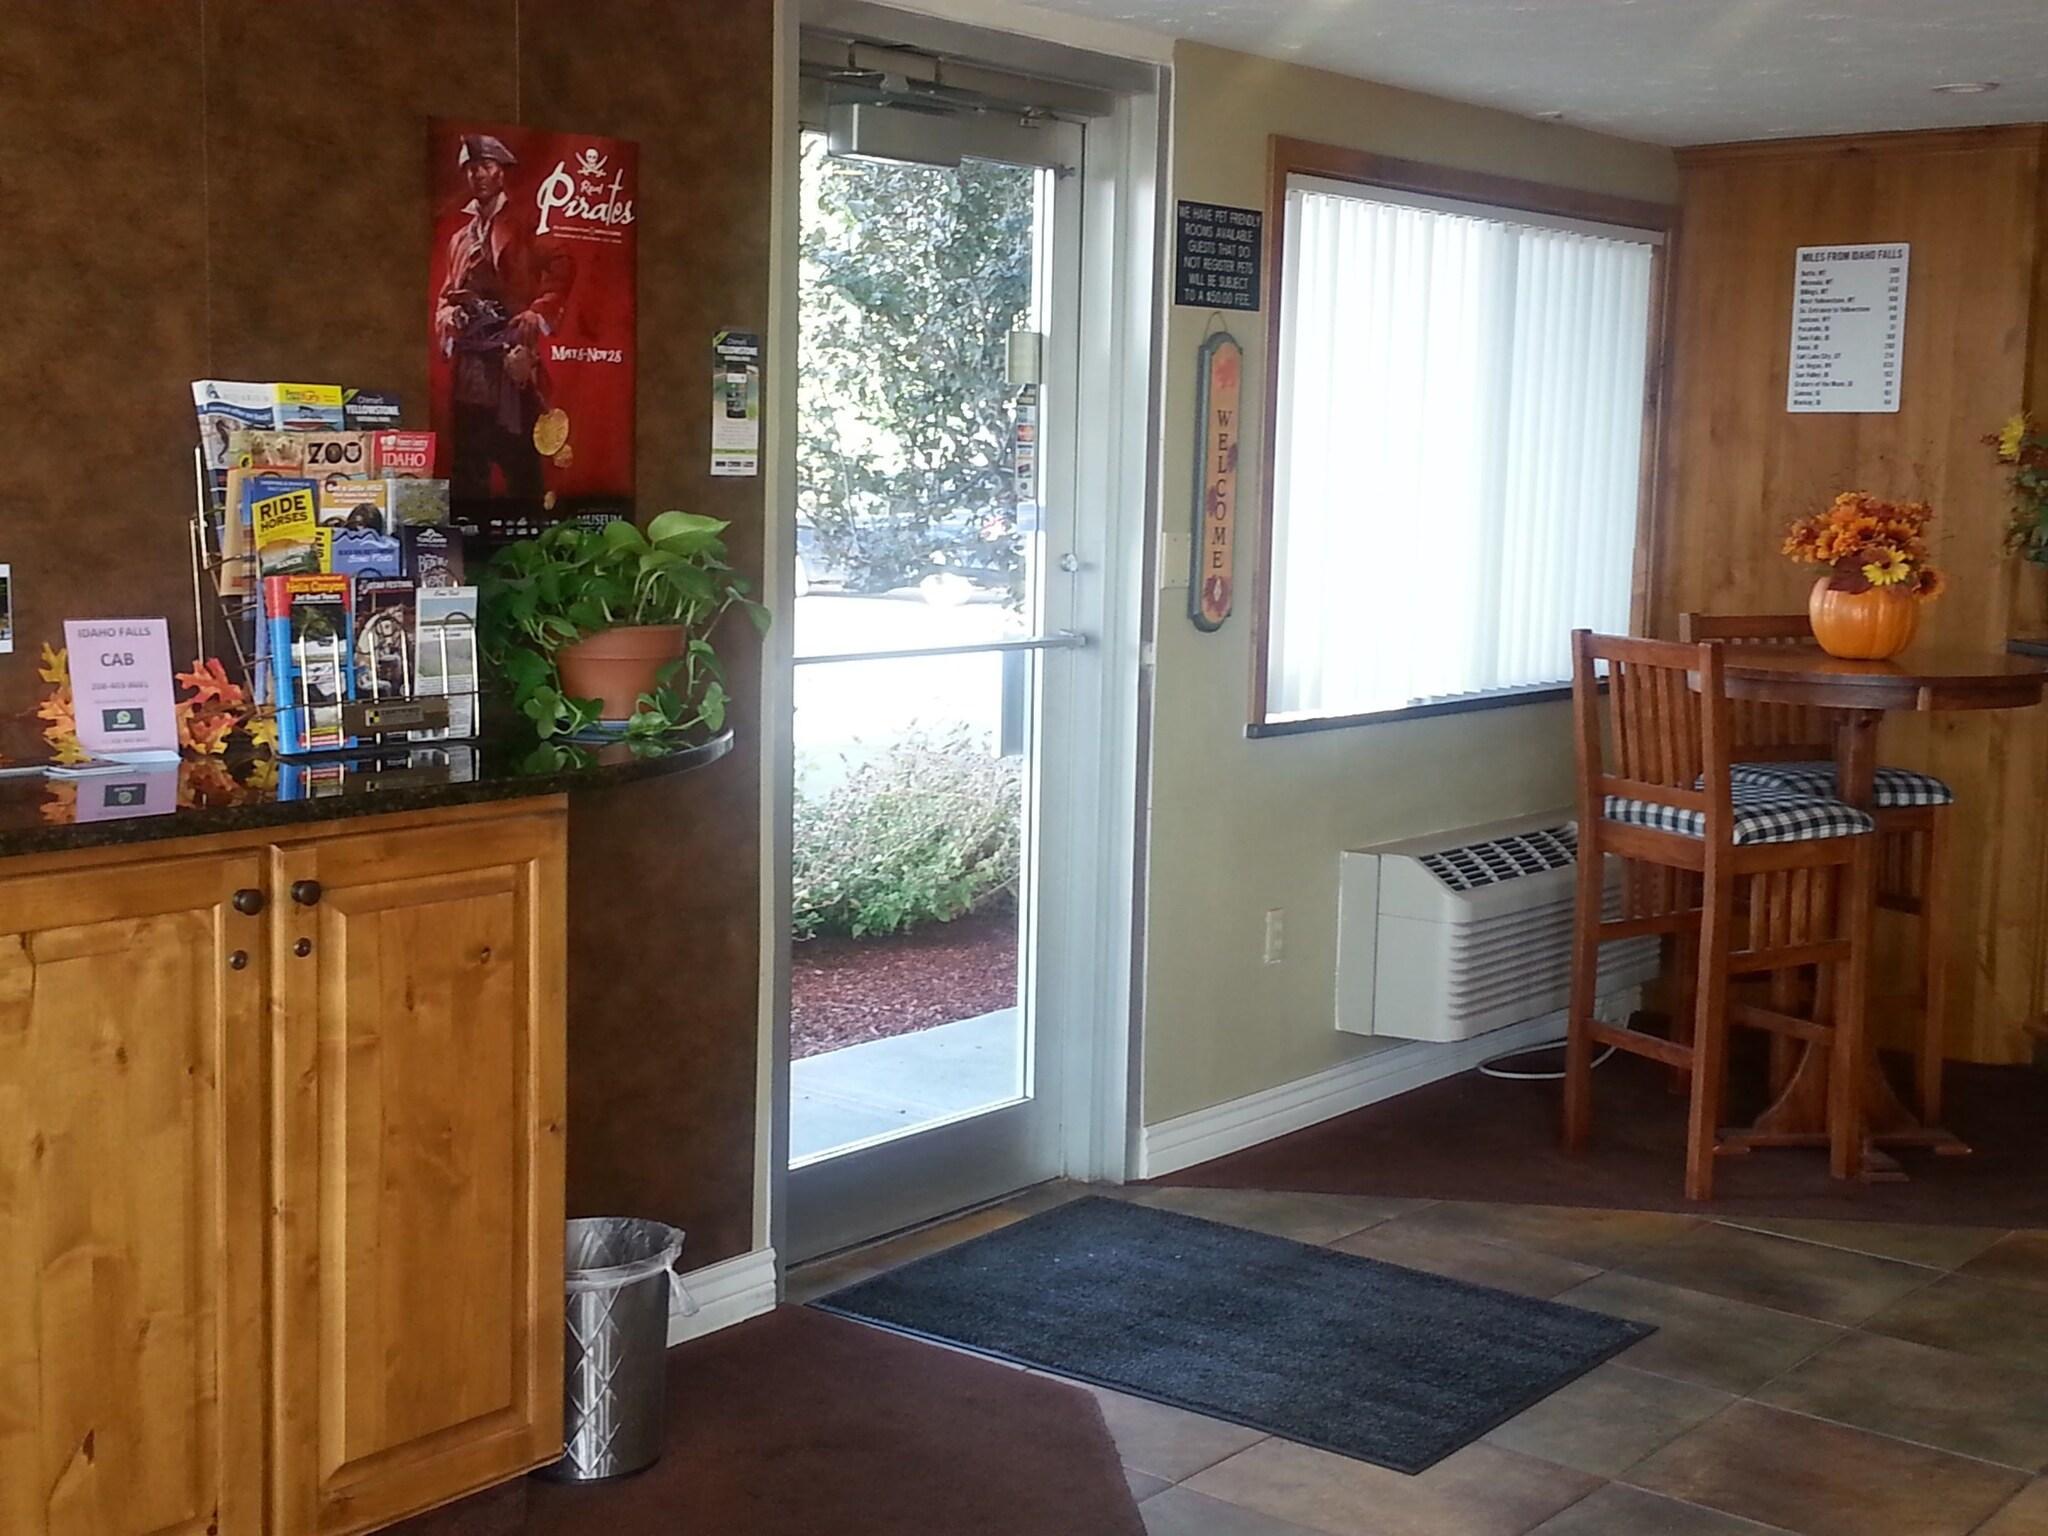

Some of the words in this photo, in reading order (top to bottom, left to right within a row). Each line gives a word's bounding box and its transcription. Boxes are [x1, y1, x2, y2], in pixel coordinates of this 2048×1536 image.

[536, 161, 635, 236] Pirates
[1185, 222, 1213, 238] ROOMS
[1183, 256, 1201, 269] NOT
[1801, 252, 1825, 263] MILES
[1827, 251, 1850, 262] FROM
[1851, 250, 1876, 261] IDAHO
[1878, 248, 1904, 260] FALLS
[308, 441, 362, 465] ZOO
[382, 452, 426, 468] IDAHO
[1211, 409, 1233, 569] WELCOME
[260, 494, 306, 521] RIDE
[260, 511, 308, 533] HORSES
[77, 627, 116, 639] IDAHO
[119, 626, 151, 637] FALLS
[100, 652, 135, 667] CAB
